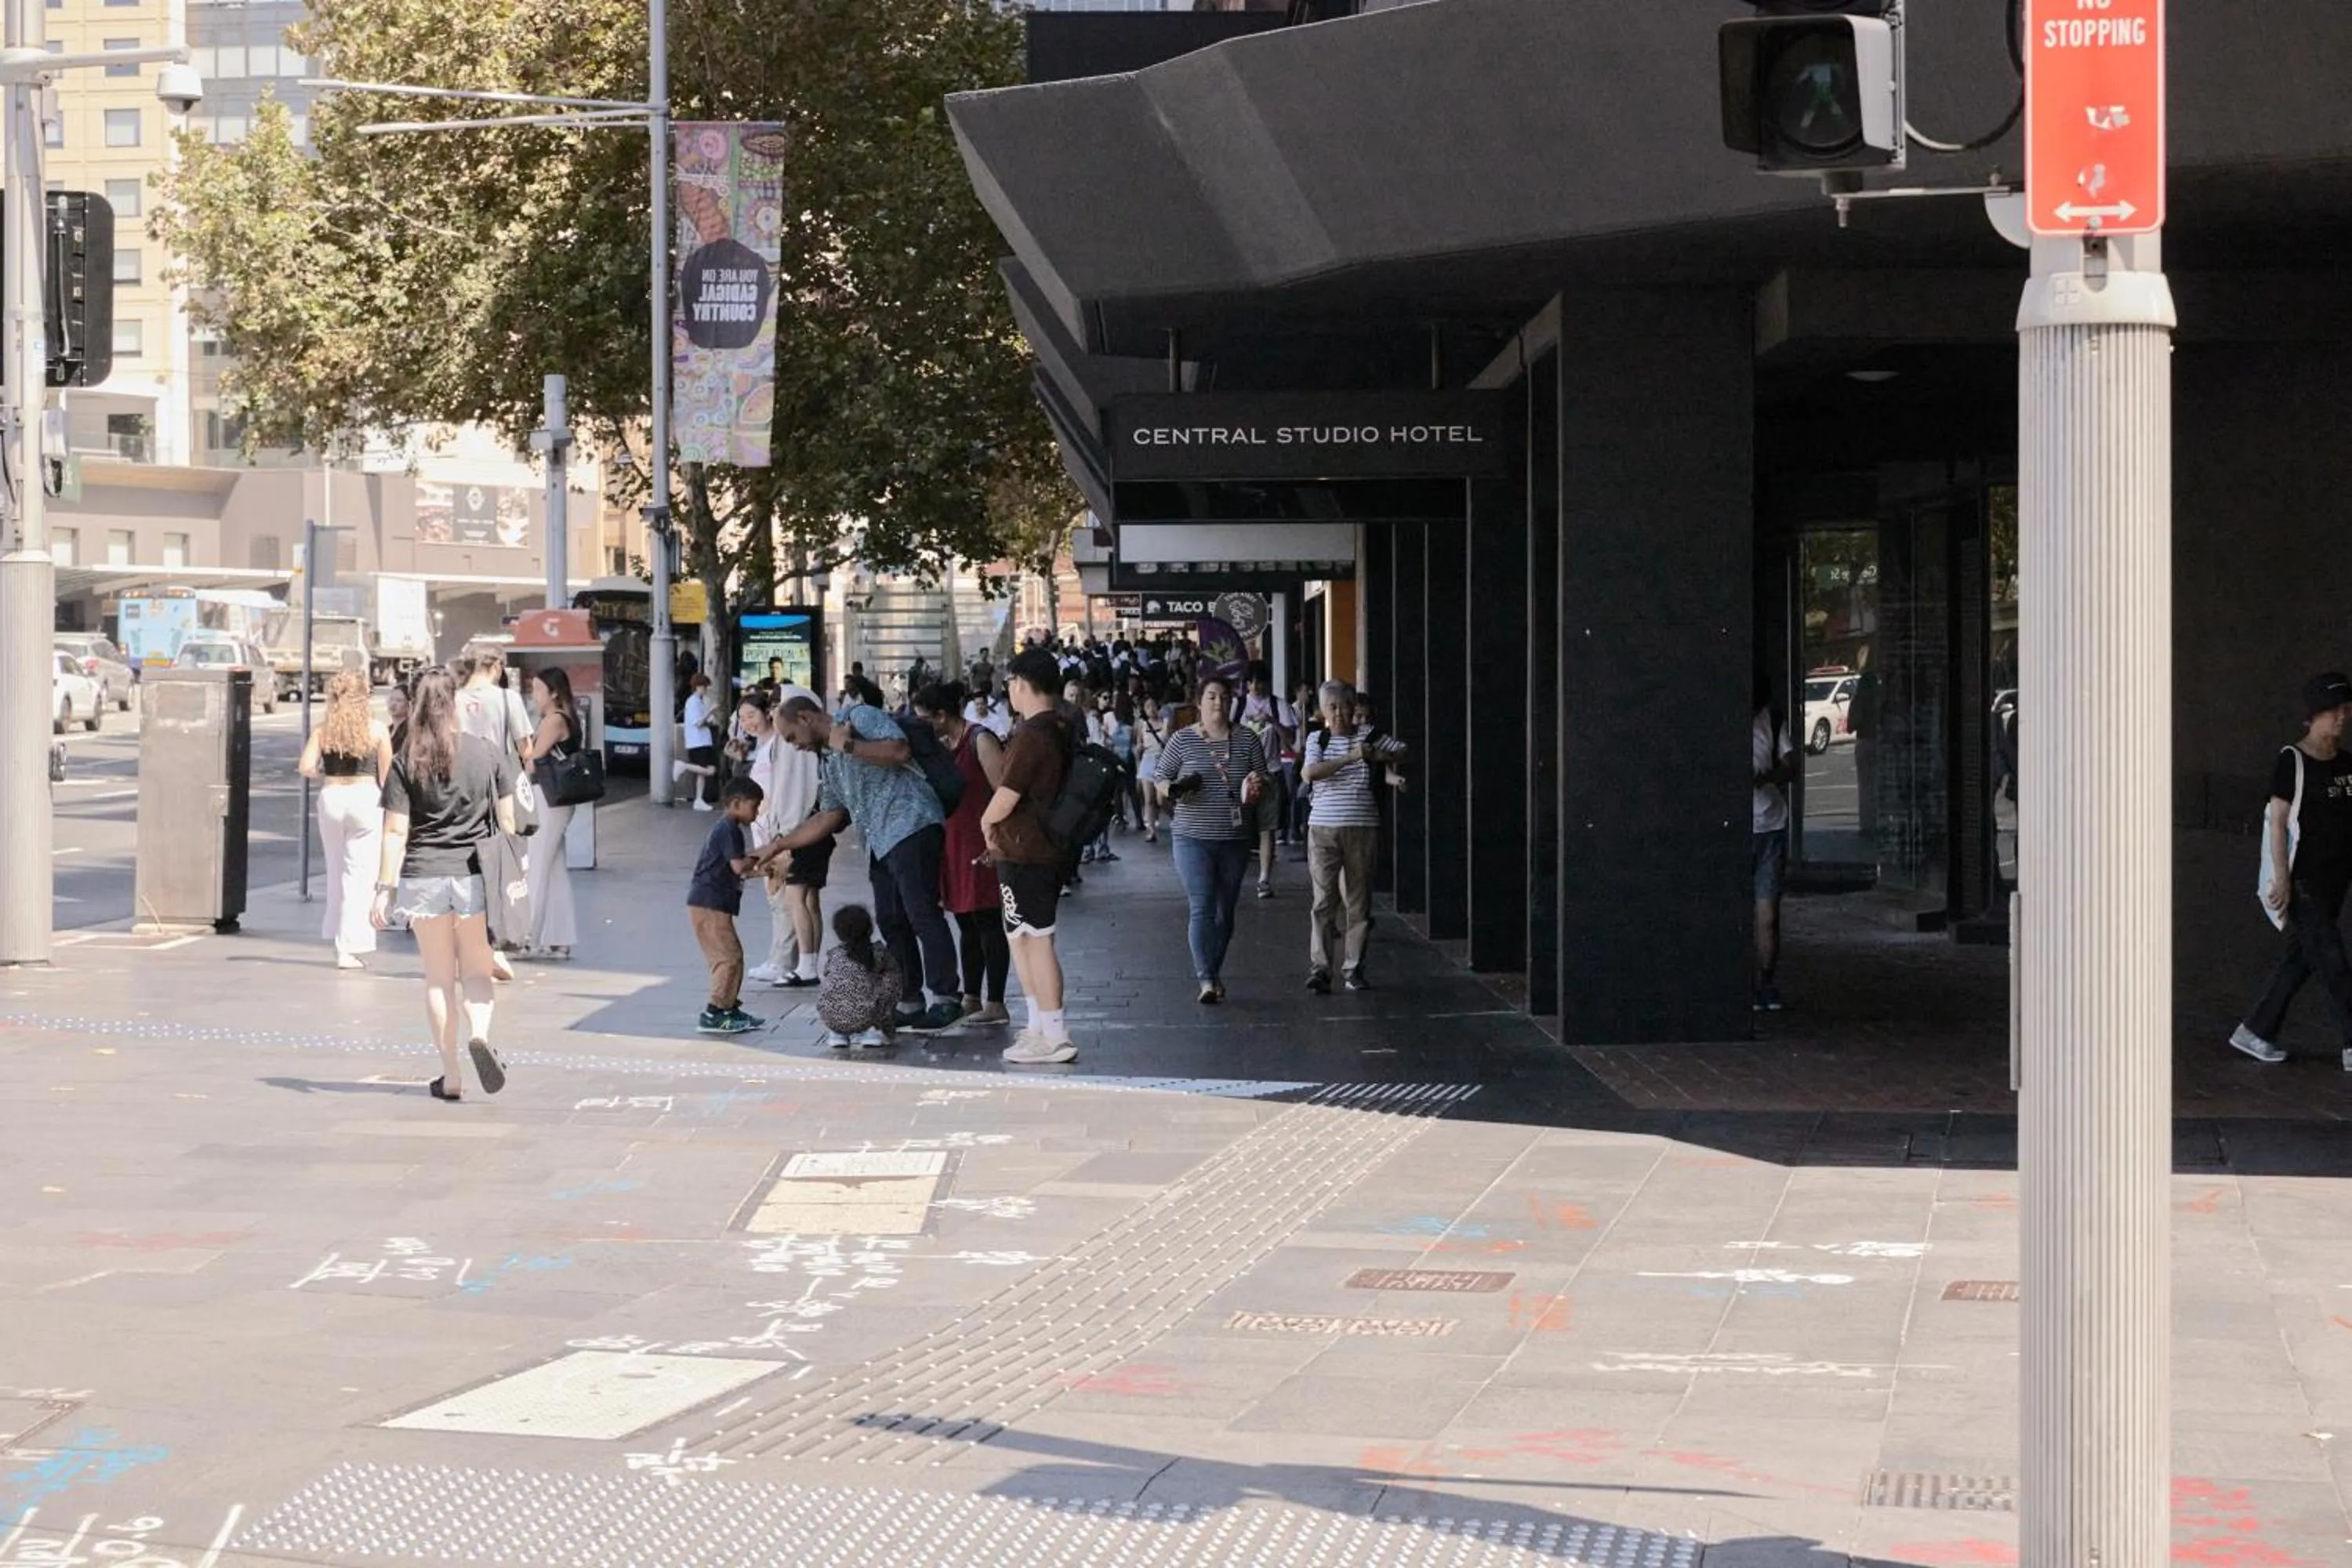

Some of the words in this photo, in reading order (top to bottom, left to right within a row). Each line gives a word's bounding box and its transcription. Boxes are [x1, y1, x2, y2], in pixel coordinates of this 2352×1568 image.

[2044, 17, 2146, 48] STOPPING
[1133, 427, 1267, 445] CENTRAL
[1276, 426, 1380, 444] STUDIO
[1390, 425, 1483, 443] HOTEL
[1166, 601, 1204, 613] TACO
